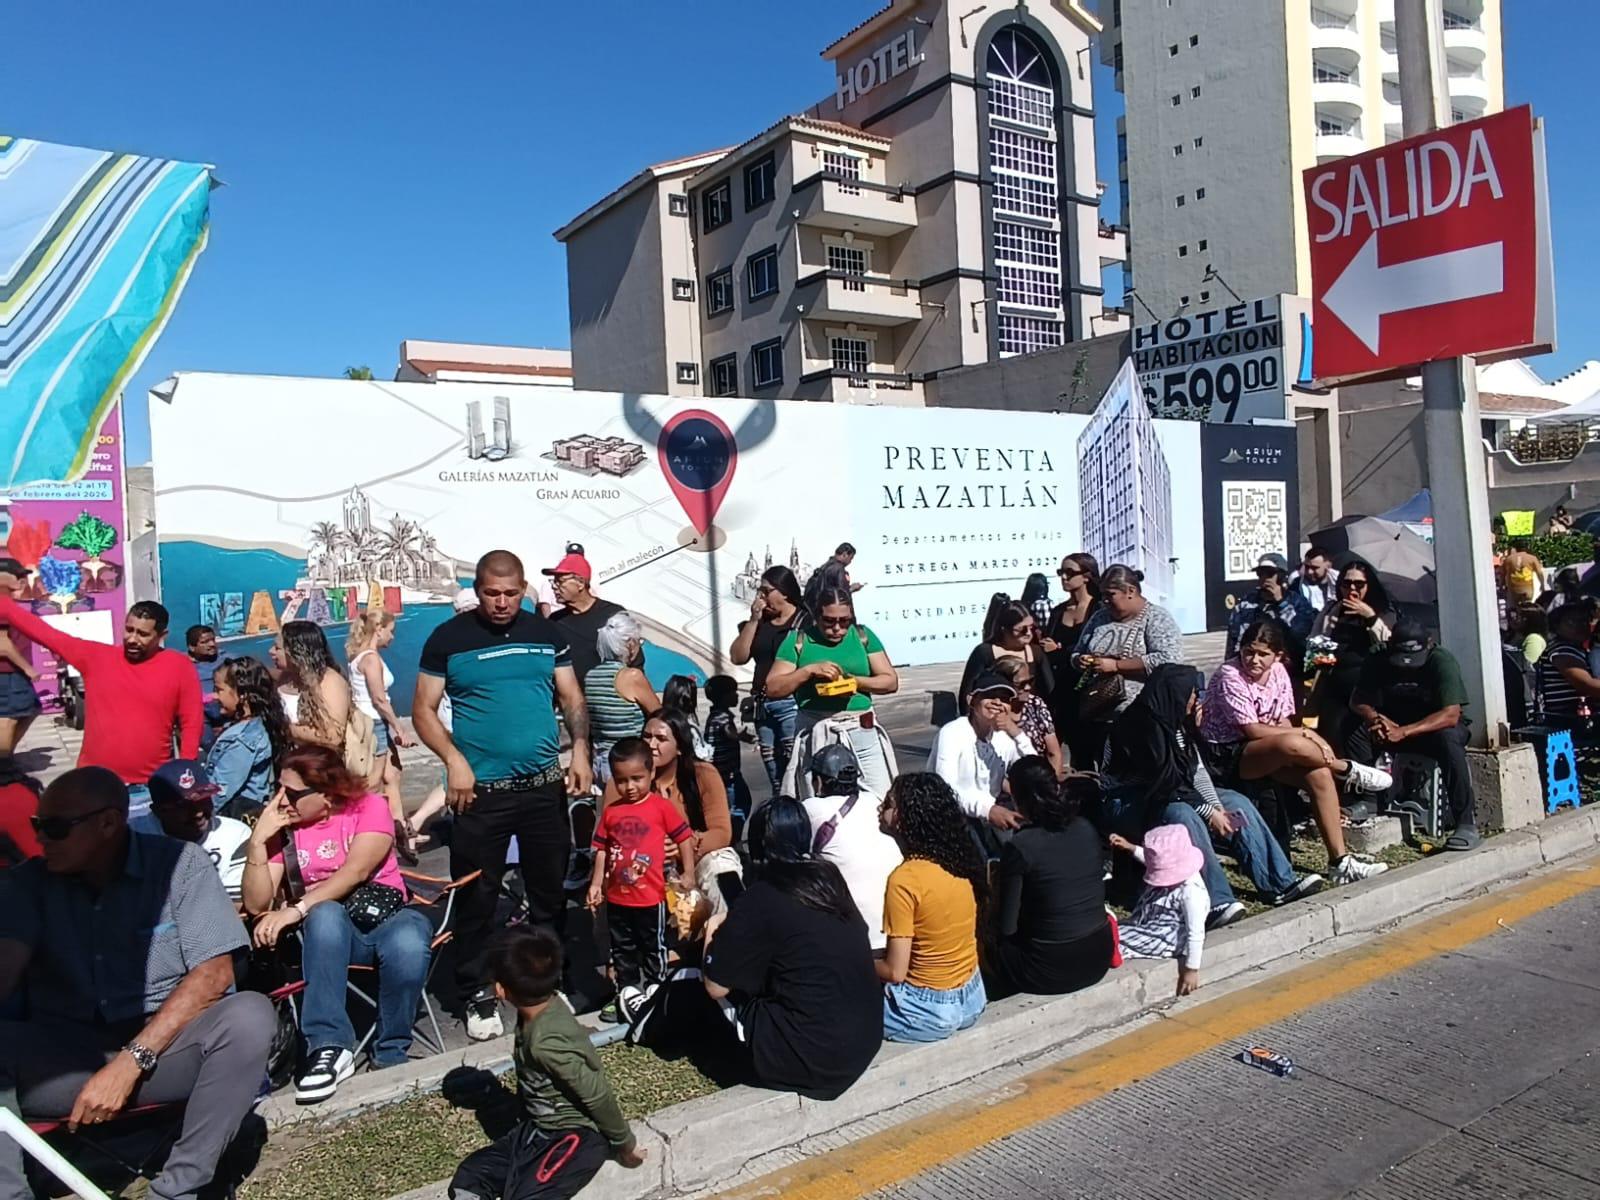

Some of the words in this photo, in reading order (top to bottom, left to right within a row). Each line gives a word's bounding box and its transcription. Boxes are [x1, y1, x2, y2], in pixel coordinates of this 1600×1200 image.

[836, 29, 925, 110] HOTEL
[1311, 128, 1504, 243] SALIDA
[1135, 300, 1277, 349] HOTEL
[1135, 325, 1278, 372] HABITACION
[883, 446, 1055, 472] PREVENTA
[1245, 447, 1282, 457] ARIUM
[438, 470, 495, 483] GALERÍAS
[499, 470, 559, 483] MAZATLÁN
[23, 490, 62, 498] febrero
[64, 490, 81, 498] del
[83, 490, 108, 498] 2026
[536, 488, 569, 500] GRAN
[571, 489, 621, 500] ACUARIO
[882, 480, 1058, 509] MAZATLÁN
[884, 559, 959, 574] ENTREGA
[968, 558, 1019, 571] MARZO
